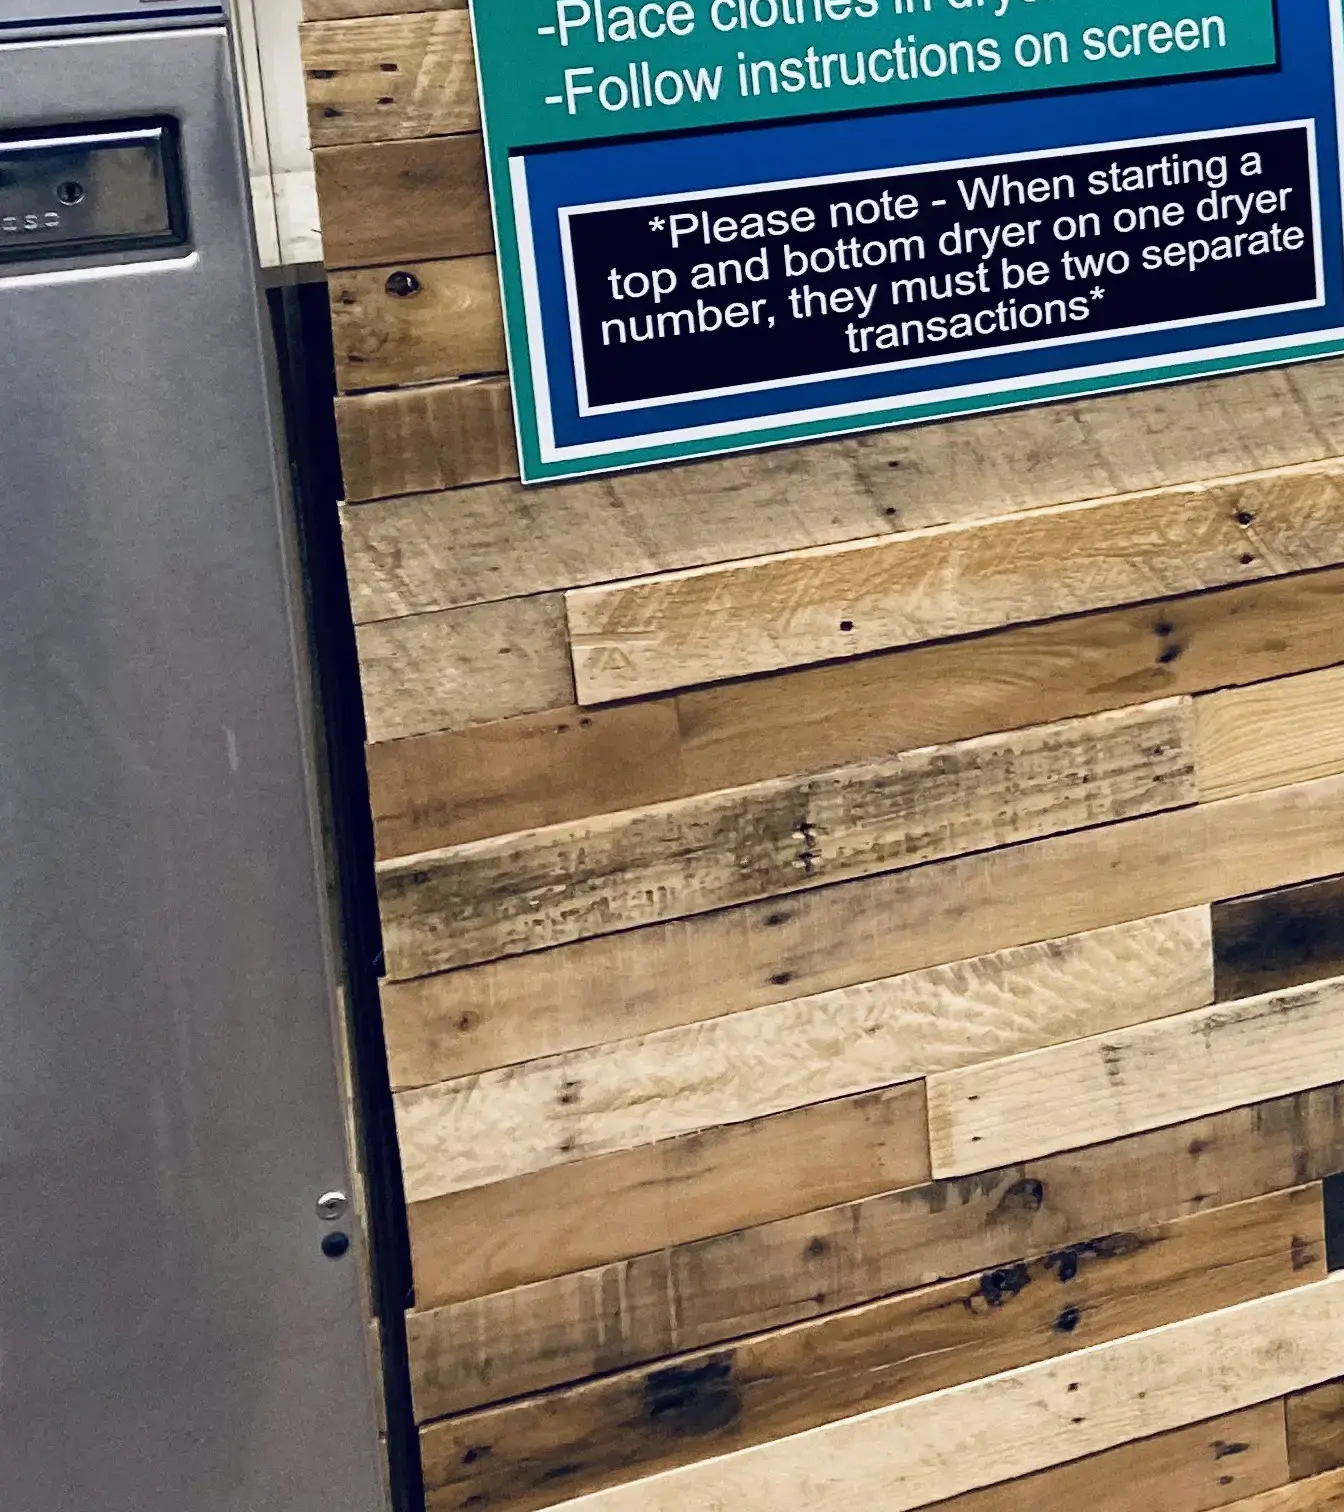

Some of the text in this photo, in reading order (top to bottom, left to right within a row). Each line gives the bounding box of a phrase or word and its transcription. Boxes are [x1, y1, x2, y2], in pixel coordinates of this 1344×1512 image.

[546, 16, 1225, 114] -Follow instructions on screen
[830, 190, 918, 227] note
[957, 174, 1074, 210] When
[1088, 154, 1227, 194] starting
[1241, 152, 1261, 175] a
[602, 223, 1304, 345] number, they must be two separate
[608, 188, 1292, 303] top and bottom dryer on one dryer
